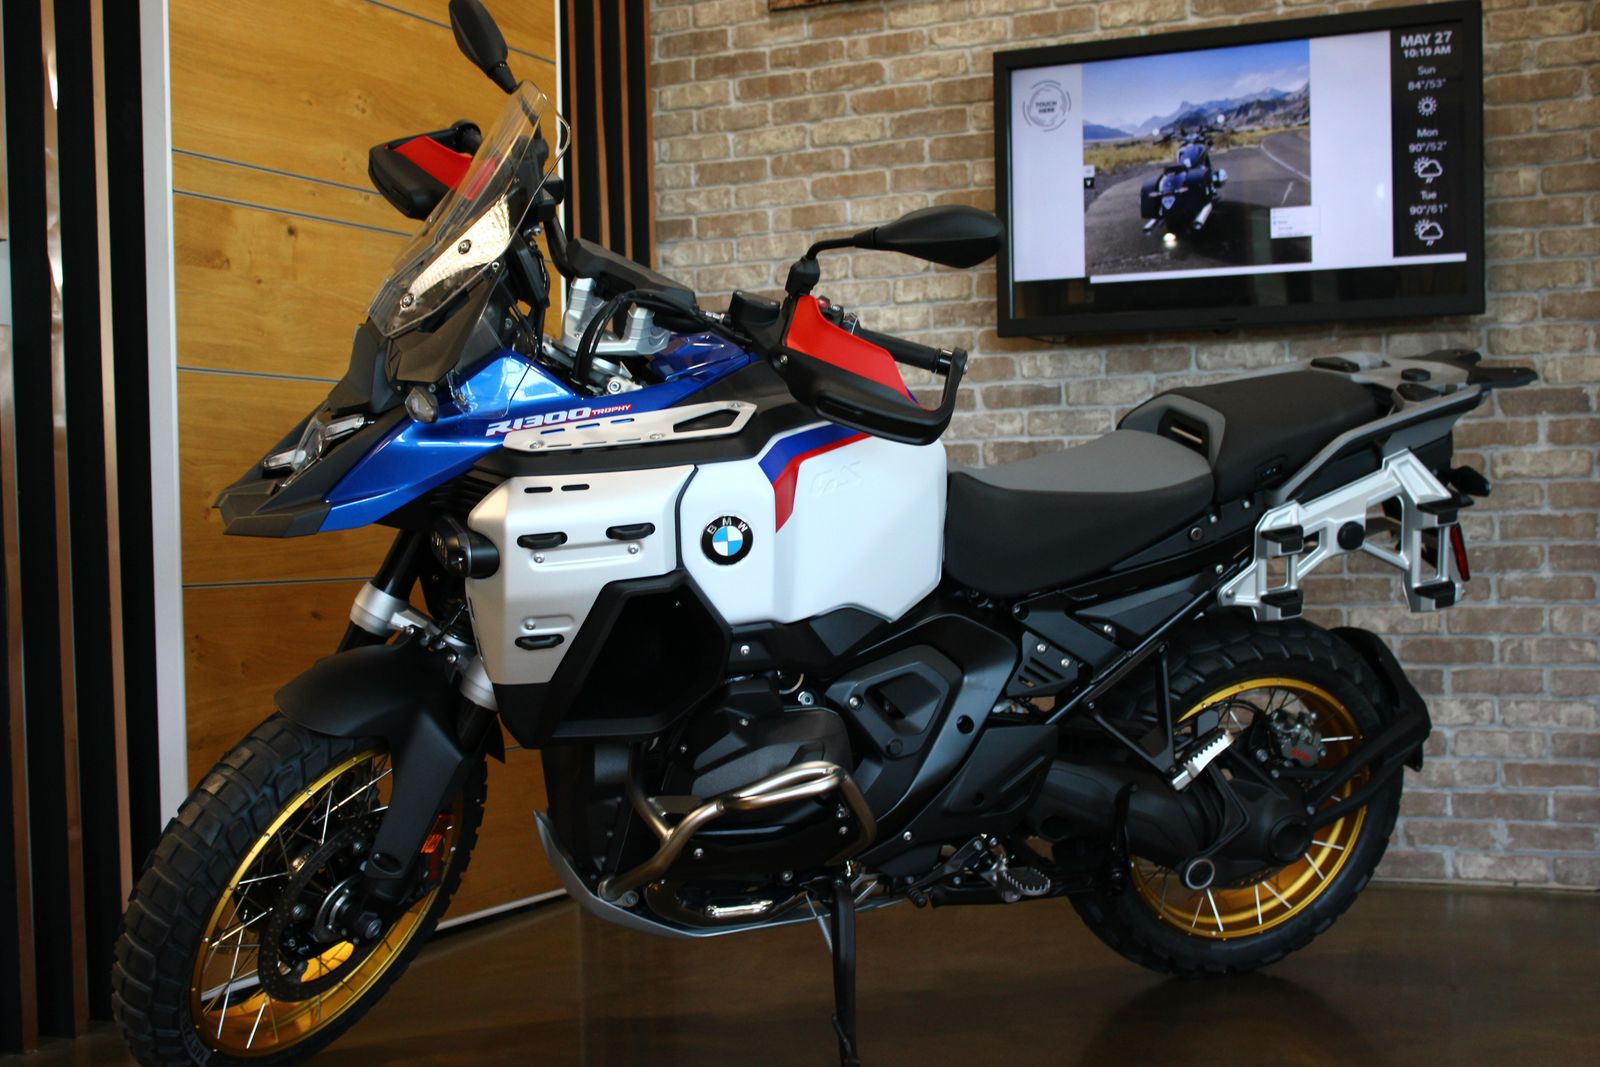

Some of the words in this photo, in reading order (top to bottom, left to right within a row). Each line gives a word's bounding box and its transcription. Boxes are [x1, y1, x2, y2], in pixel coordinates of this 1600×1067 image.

[1400, 32, 1432, 47] MAY
[1434, 30, 1453, 45] 27
[1403, 47, 1432, 58] 10:19
[1433, 45, 1452, 56] AM
[1417, 65, 1437, 76] Sun
[1416, 127, 1439, 138] Mon
[1420, 190, 1438, 201] Tue
[591, 404, 632, 417] TROPHY
[706, 517, 748, 535] BMW
